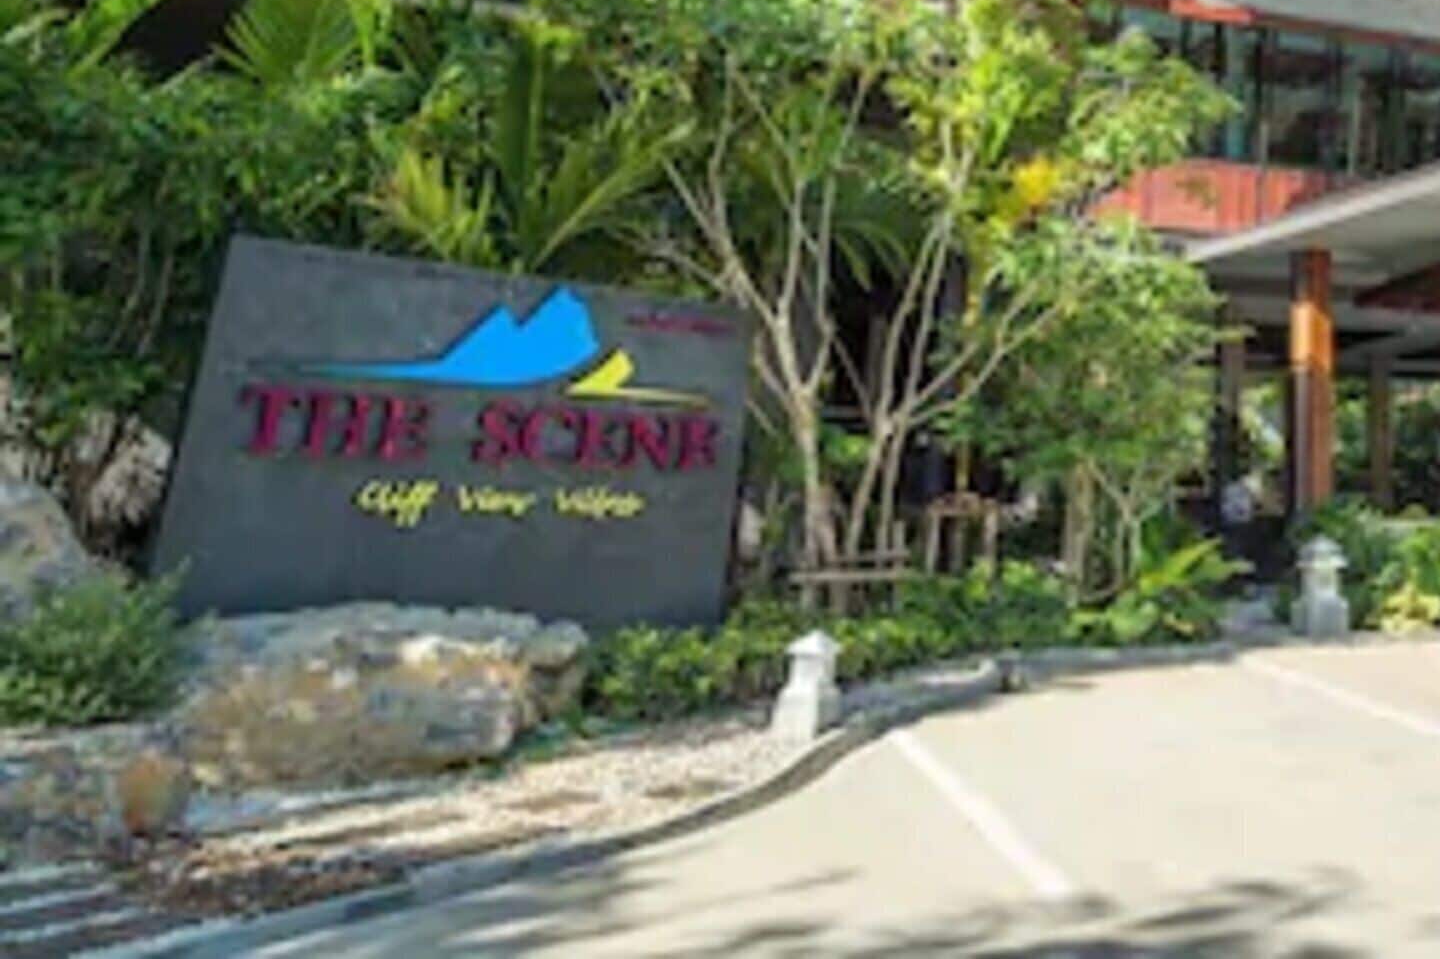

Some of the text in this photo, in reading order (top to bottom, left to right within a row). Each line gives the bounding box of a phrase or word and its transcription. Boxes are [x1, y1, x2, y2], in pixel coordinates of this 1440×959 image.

[240, 383, 722, 471] THE SCENE
[354, 479, 441, 528] Cliff
